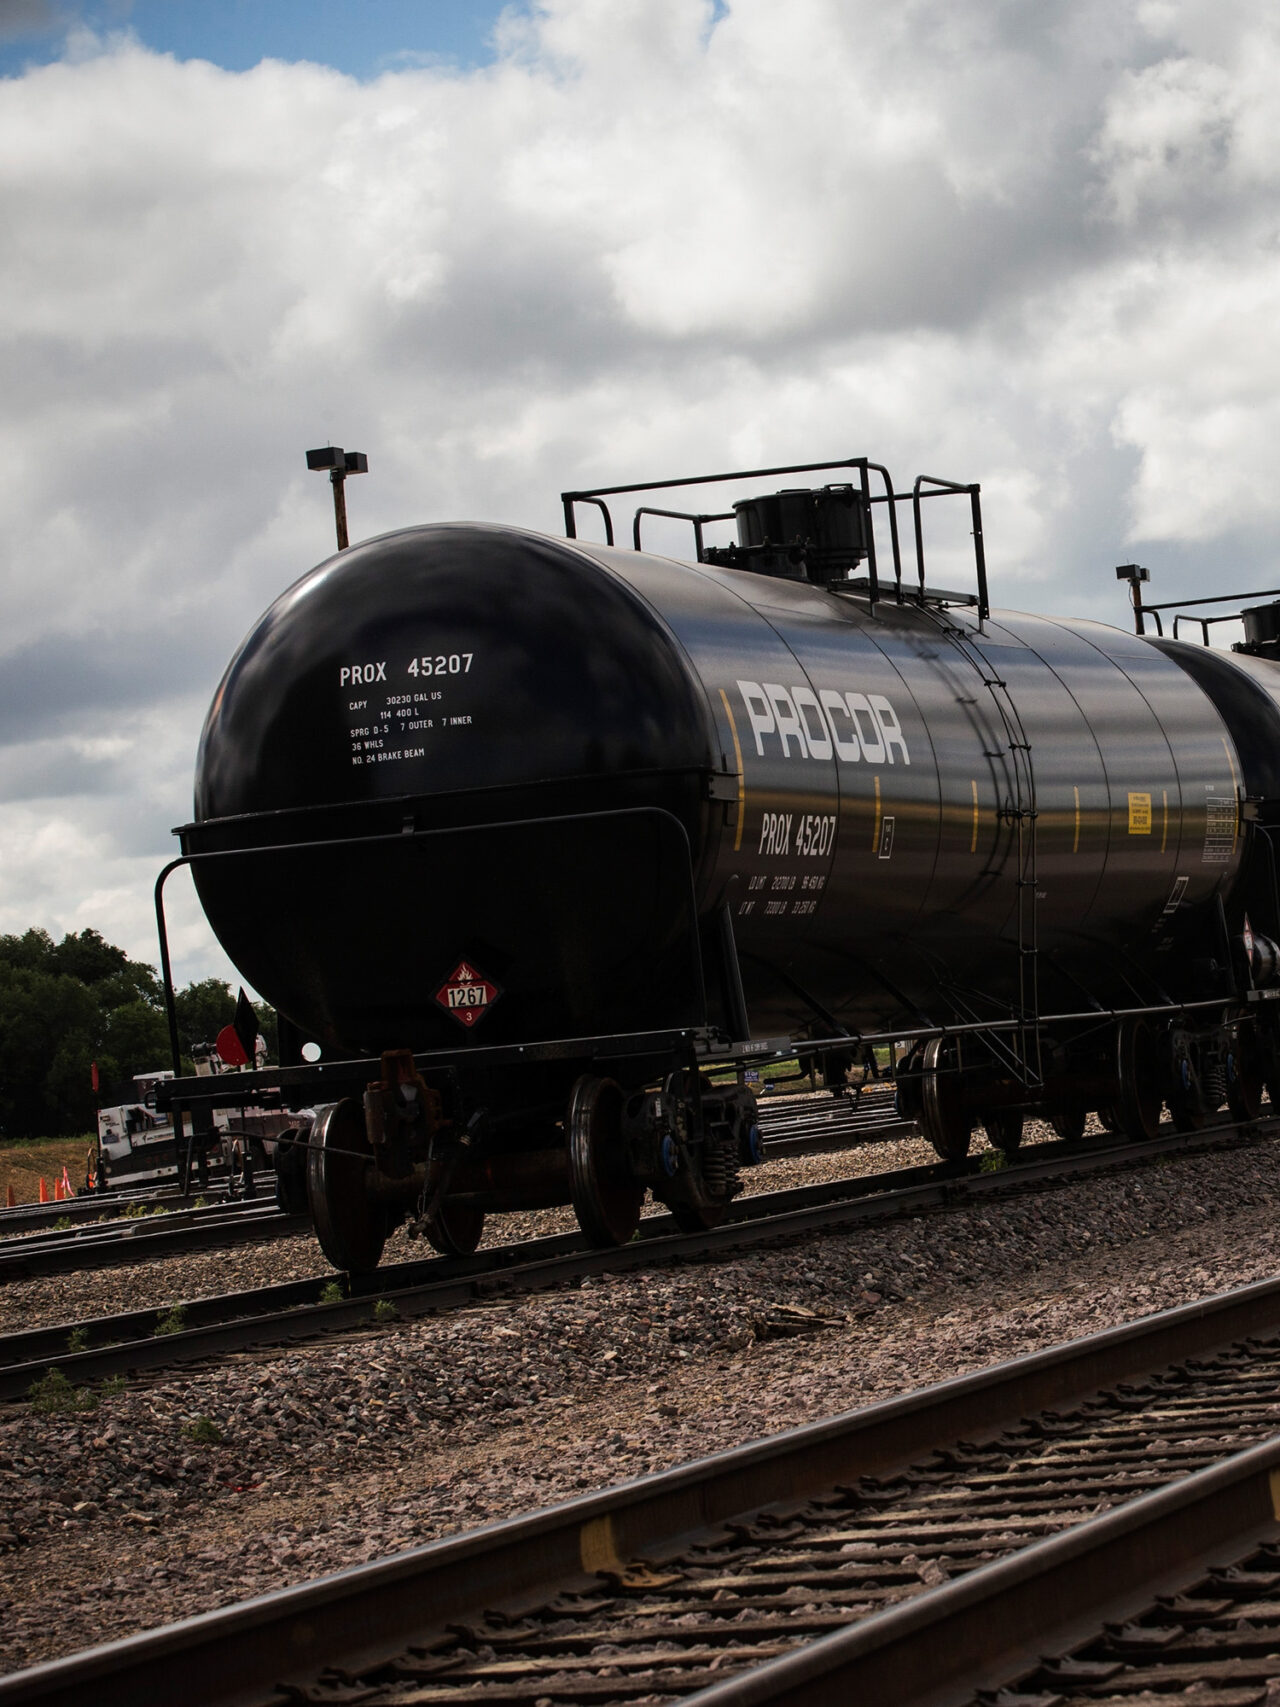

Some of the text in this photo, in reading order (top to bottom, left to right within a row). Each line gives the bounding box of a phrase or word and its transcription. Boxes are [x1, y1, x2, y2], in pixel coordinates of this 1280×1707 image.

[339, 653, 474, 688] PROX 45207
[349, 691, 442, 711] CAPY 30230 GAL US
[380, 707, 420, 719] 114 400 L
[736, 679, 911, 765] PROCOR
[350, 727, 370, 738] SPRG
[400, 722, 405, 731] 7
[408, 719, 434, 730] OUTER
[441, 718, 447, 727] 7
[450, 715, 473, 726] INNER
[363, 739, 384, 750] WHLS
[366, 754, 376, 764] 24
[377, 751, 402, 762] BRAKE
[404, 748, 425, 759] BEAM
[758, 812, 837, 857] PROX 45207
[449, 987, 484, 1006] 1267
[466, 1011, 473, 1021] 3
